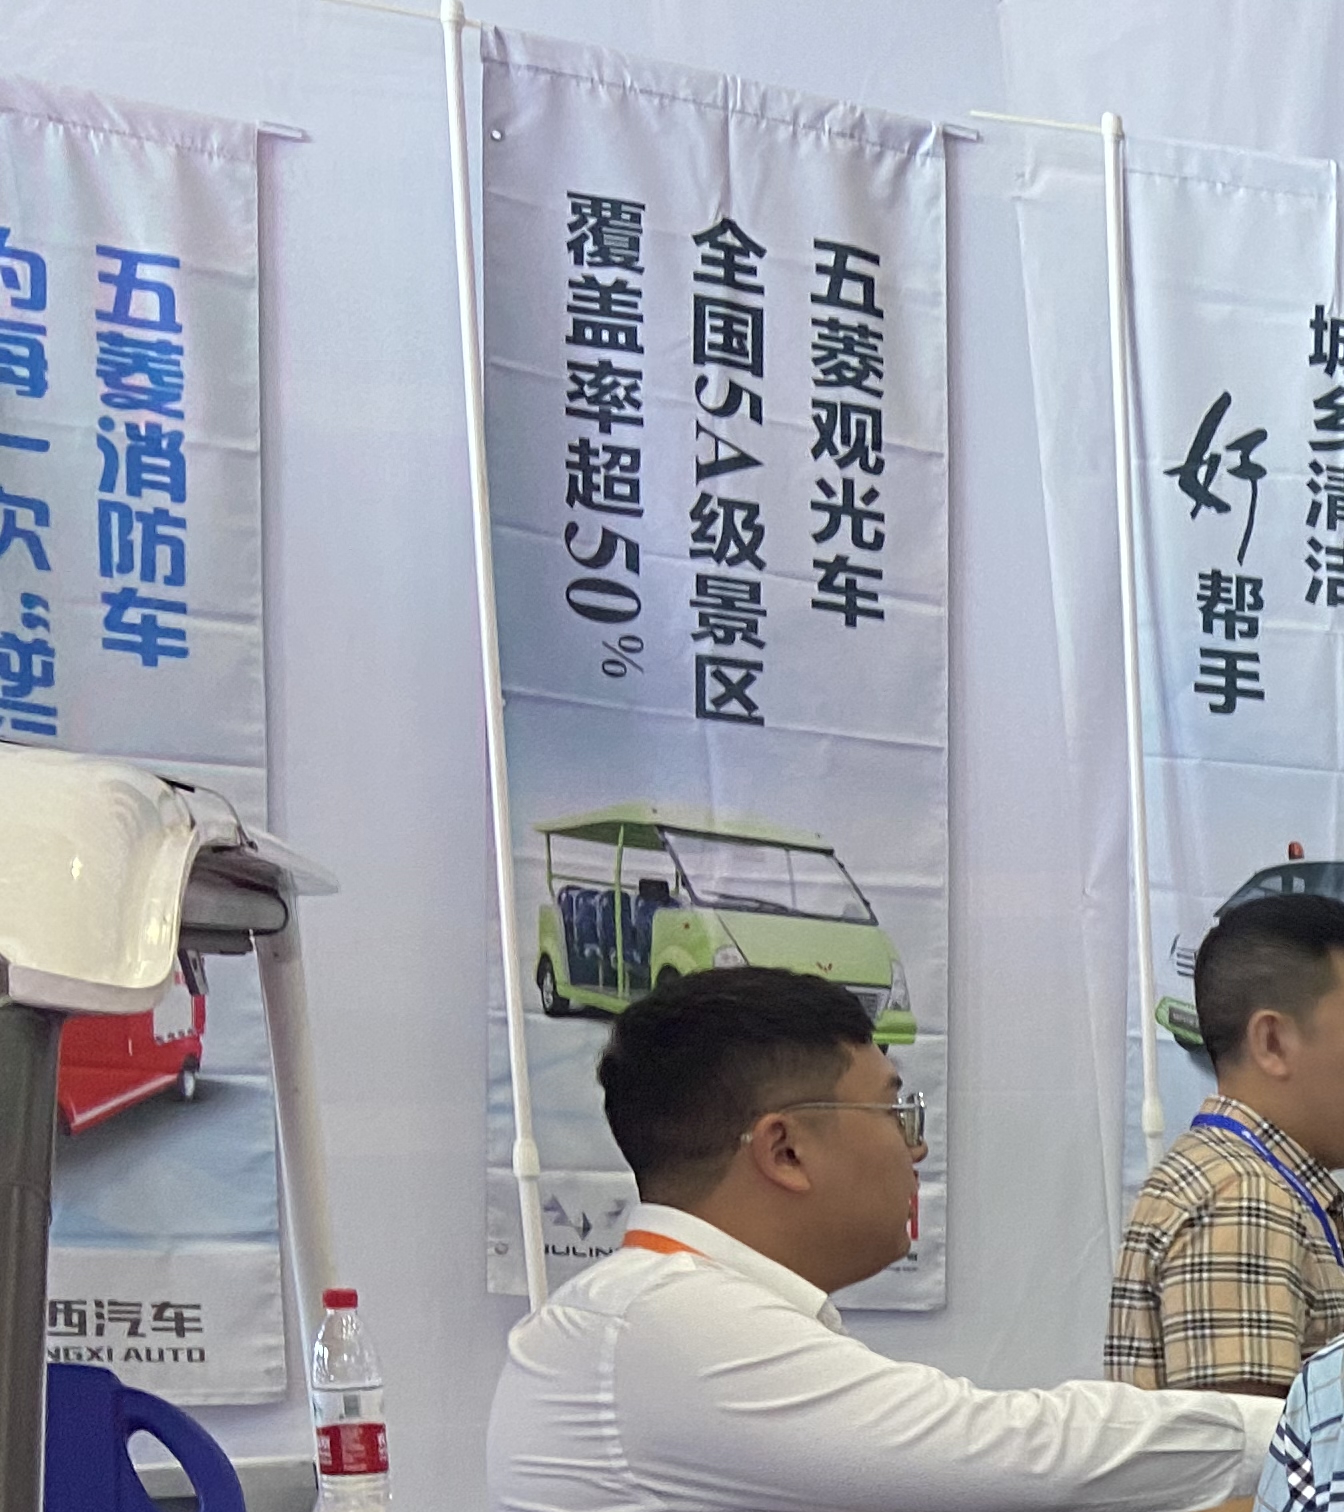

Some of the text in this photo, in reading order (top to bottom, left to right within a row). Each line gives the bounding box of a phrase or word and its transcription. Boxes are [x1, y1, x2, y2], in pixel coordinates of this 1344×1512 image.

[95, 244, 189, 667] 五菱消防车
[565, 191, 646, 679] 覆盖率超50%
[690, 217, 767, 727] 全国5A级景区
[810, 238, 886, 629] 五菱观光车
[1162, 392, 1268, 715] 好帮手
[124, 1346, 205, 1363] AUTO
[544, 1243, 626, 1257] ULIN
